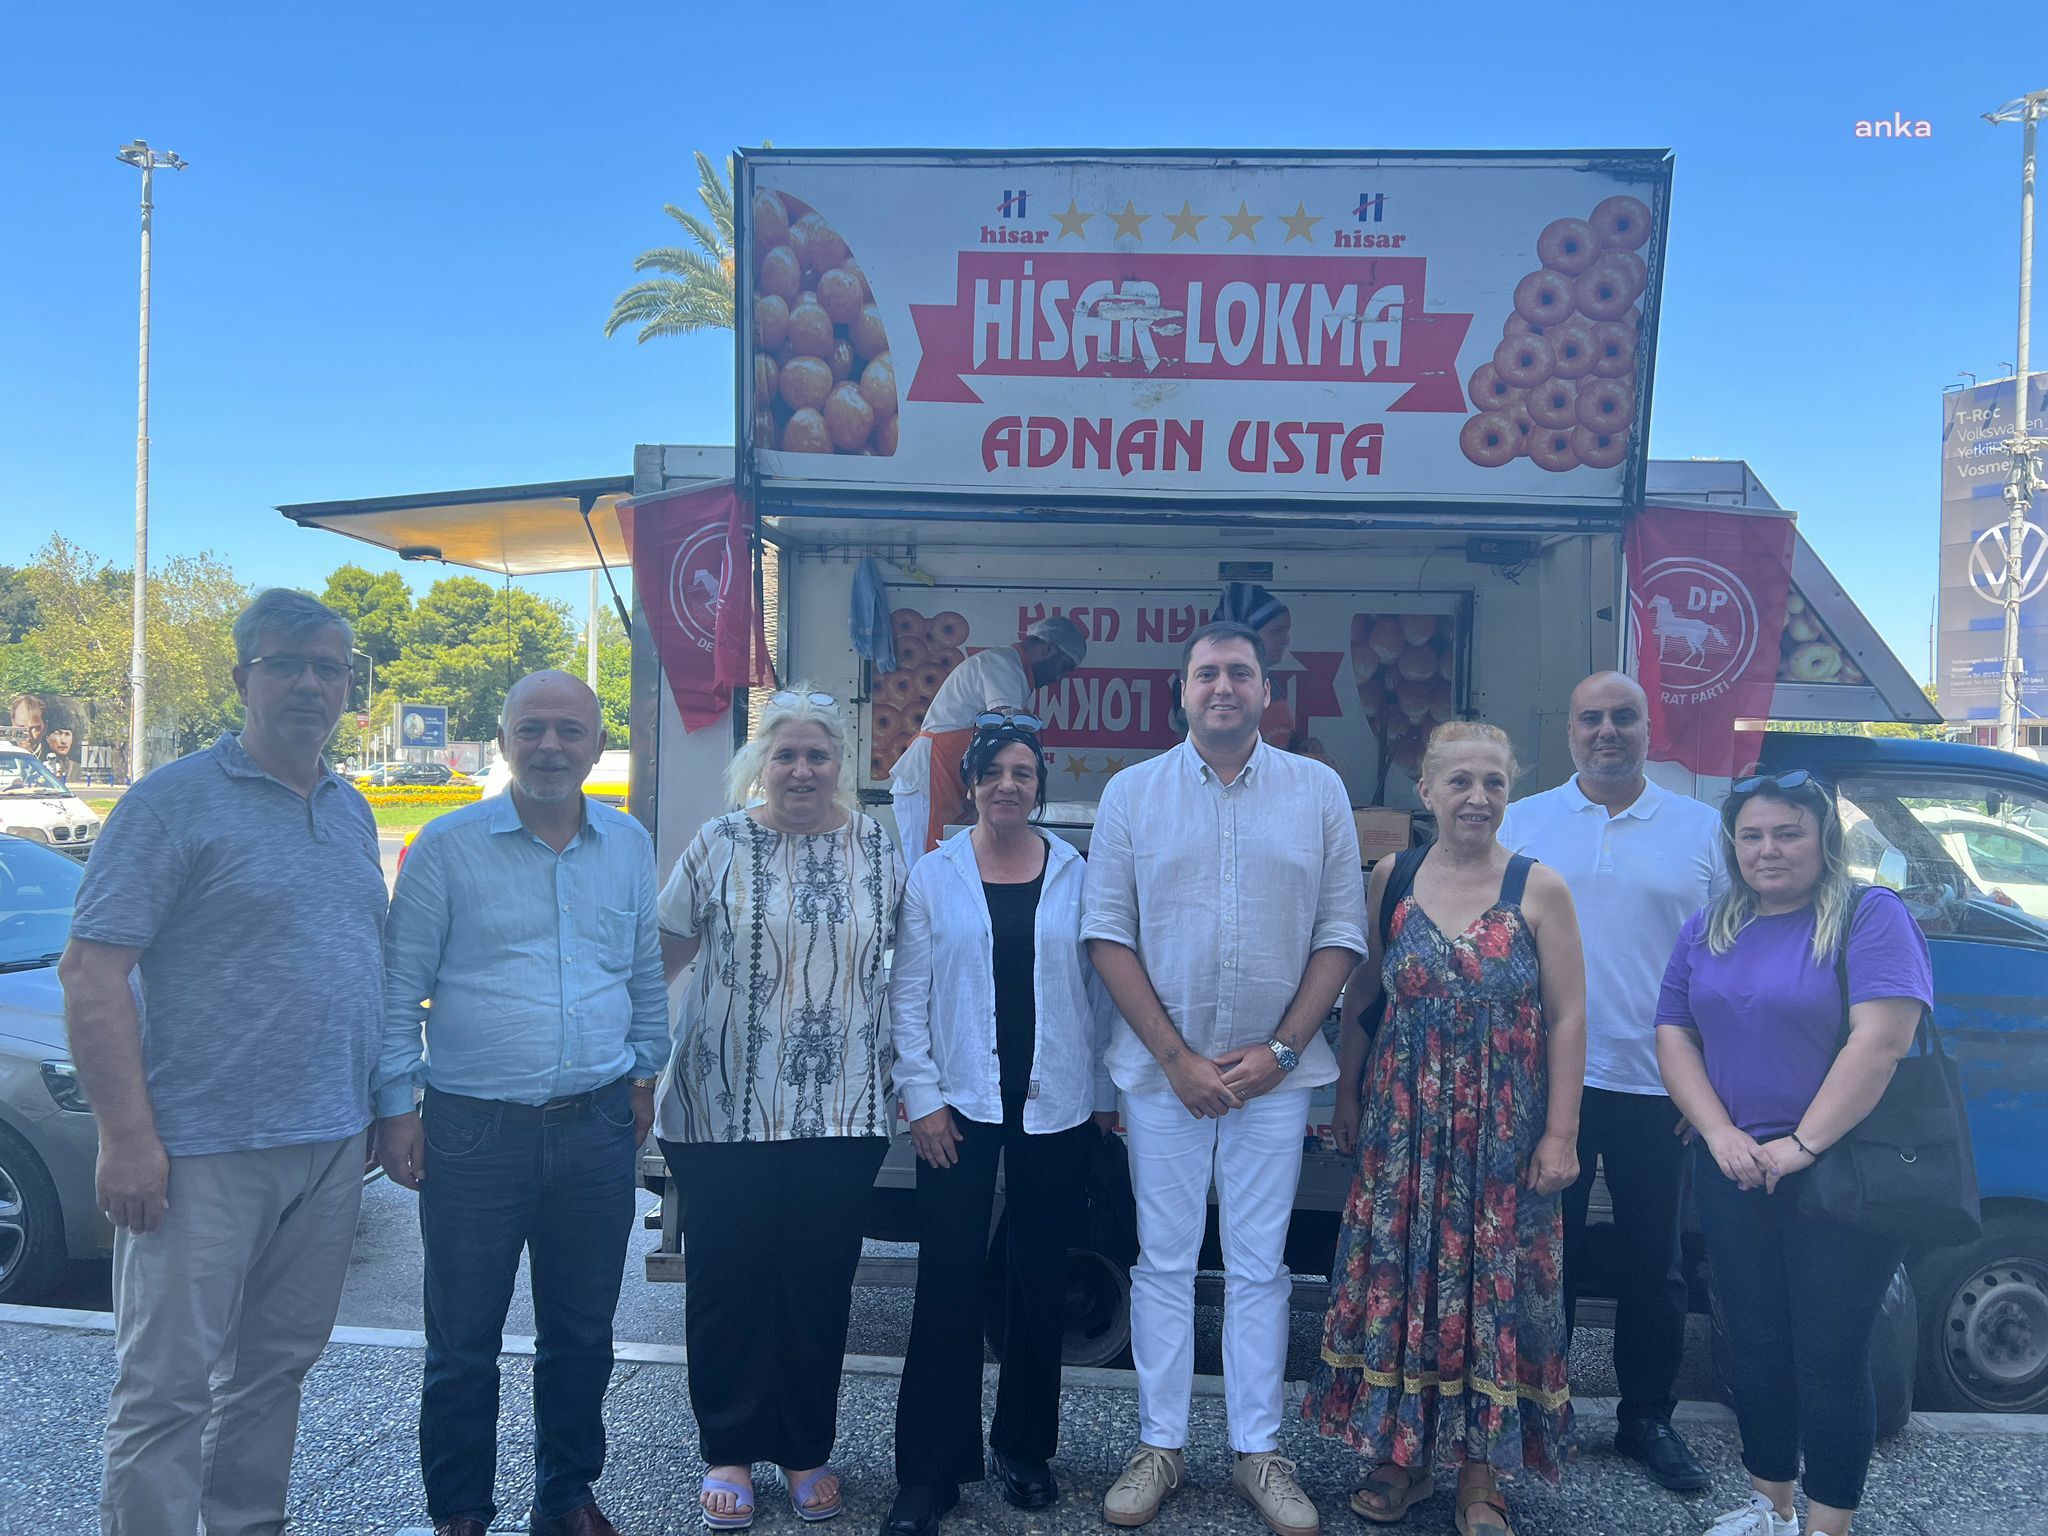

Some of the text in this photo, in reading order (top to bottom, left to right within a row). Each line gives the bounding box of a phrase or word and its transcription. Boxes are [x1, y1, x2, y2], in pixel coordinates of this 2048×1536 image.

[979, 225, 1050, 244] hisar
[1333, 229, 1407, 249] hisar
[972, 259, 1405, 377] HİSAR LOKMA
[1956, 407, 2001, 425] T-Roc
[1956, 418, 2043, 442] Volkswaen
[981, 415, 1385, 482] ADNAN USTA
[1687, 585, 1729, 615] DP
[1691, 678, 1731, 705] PARTİ
